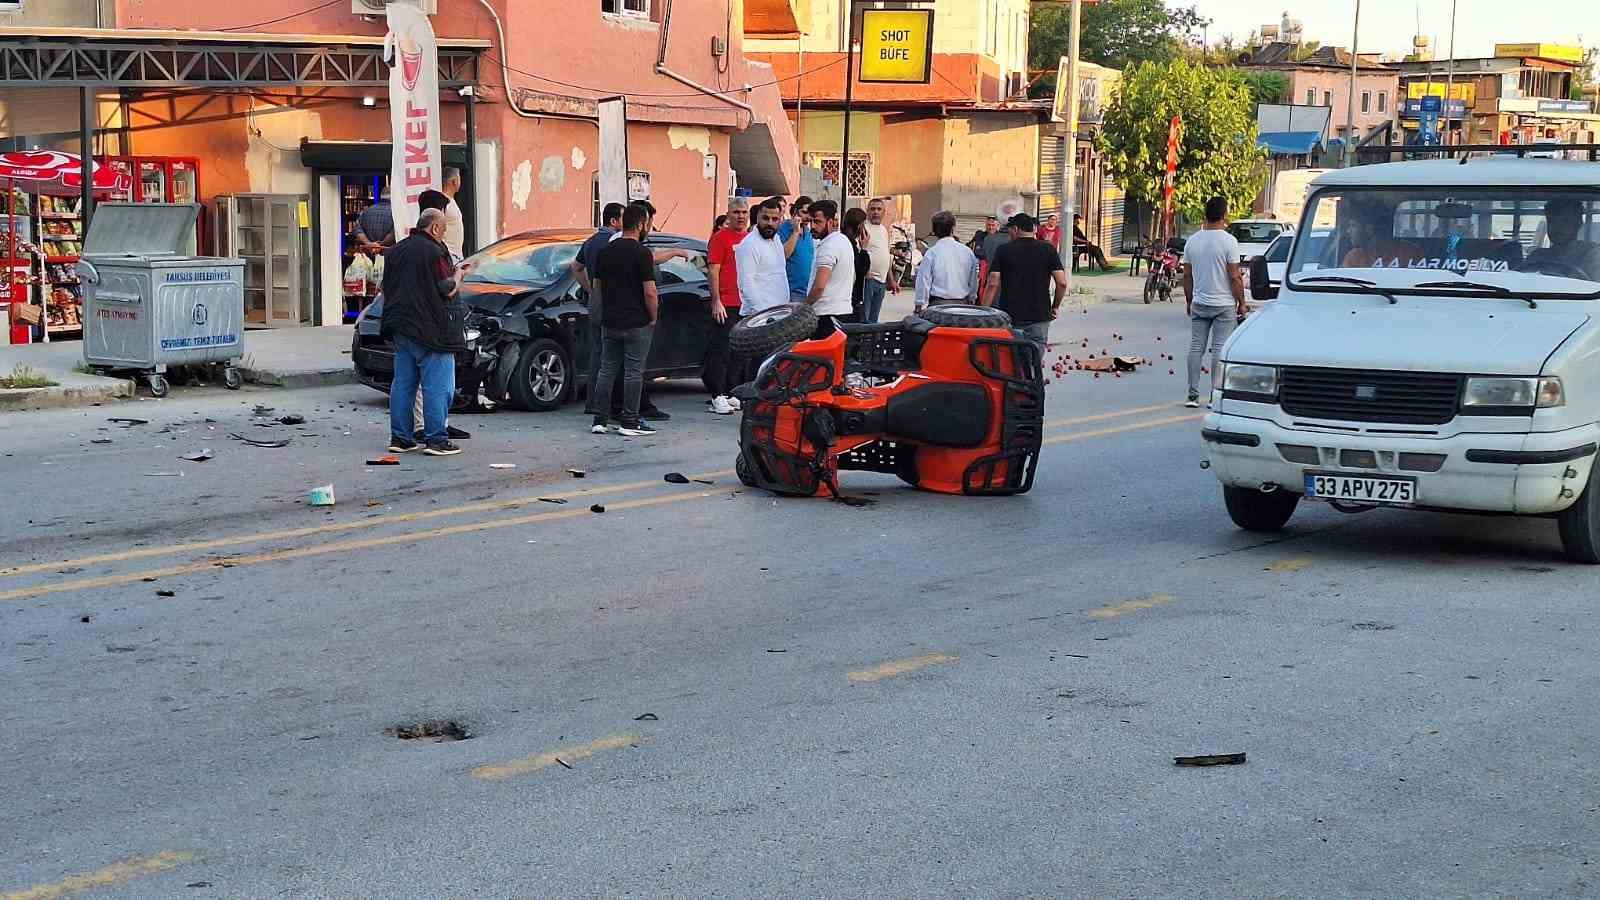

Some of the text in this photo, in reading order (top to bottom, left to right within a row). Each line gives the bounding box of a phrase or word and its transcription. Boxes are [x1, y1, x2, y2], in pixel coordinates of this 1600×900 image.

[880, 30, 911, 42] SHOT
[880, 45, 910, 60] BÜFE
[1408, 258, 1440, 269] LAR
[1441, 257, 1509, 271] MOBİLYA
[1316, 478, 1337, 496] 33
[1341, 480, 1374, 497] APV
[1378, 481, 1411, 501] 275
